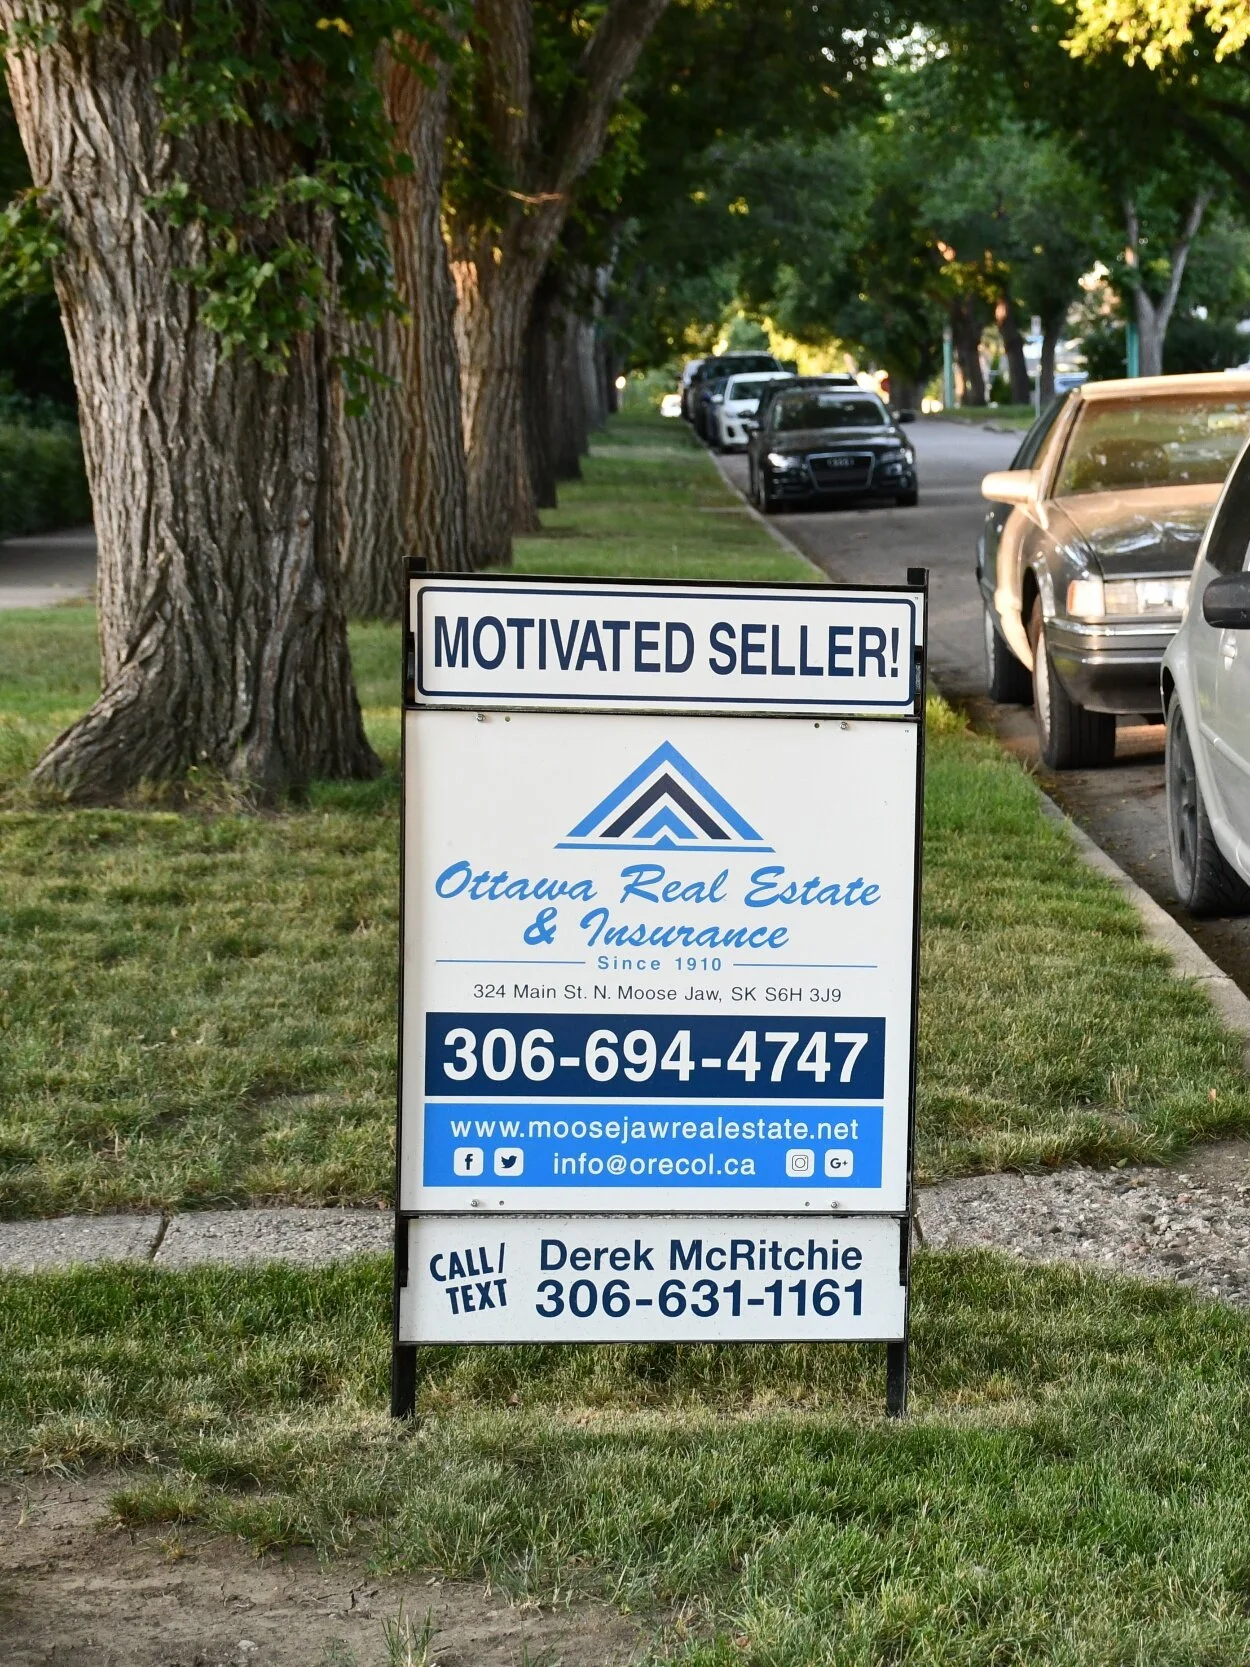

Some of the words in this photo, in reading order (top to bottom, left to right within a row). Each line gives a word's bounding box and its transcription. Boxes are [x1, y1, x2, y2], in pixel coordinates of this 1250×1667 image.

[434, 615, 695, 674] MOTIVATED
[708, 621, 900, 678] SELLER!
[434, 860, 597, 902] Ottawa
[619, 863, 729, 904] Real
[743, 865, 881, 908] Estate
[523, 906, 558, 946] &
[579, 907, 791, 949] Insurance
[597, 955, 661, 971] Since
[675, 957, 722, 972] 1910
[473, 983, 506, 999] 324
[513, 984, 556, 999] Main
[563, 985, 588, 1000] St.
[594, 985, 611, 1001] N.
[619, 985, 677, 1001] Moose
[684, 986, 722, 1003] Jaw,
[731, 987, 757, 1002] SK
[765, 987, 802, 1002] S6H
[809, 988, 842, 1003] 3J9
[443, 1027, 869, 1083] 306-694-4747
[450, 1116, 859, 1144] www.moosejawrealestate.net
[554, 1152, 756, 1176] info@orecol.ca
[430, 1242, 506, 1281] CALL/
[540, 1238, 655, 1272] Derek
[669, 1238, 863, 1272] McRitchie
[445, 1278, 508, 1315] TEXT
[535, 1278, 863, 1318] 306-631-1161
